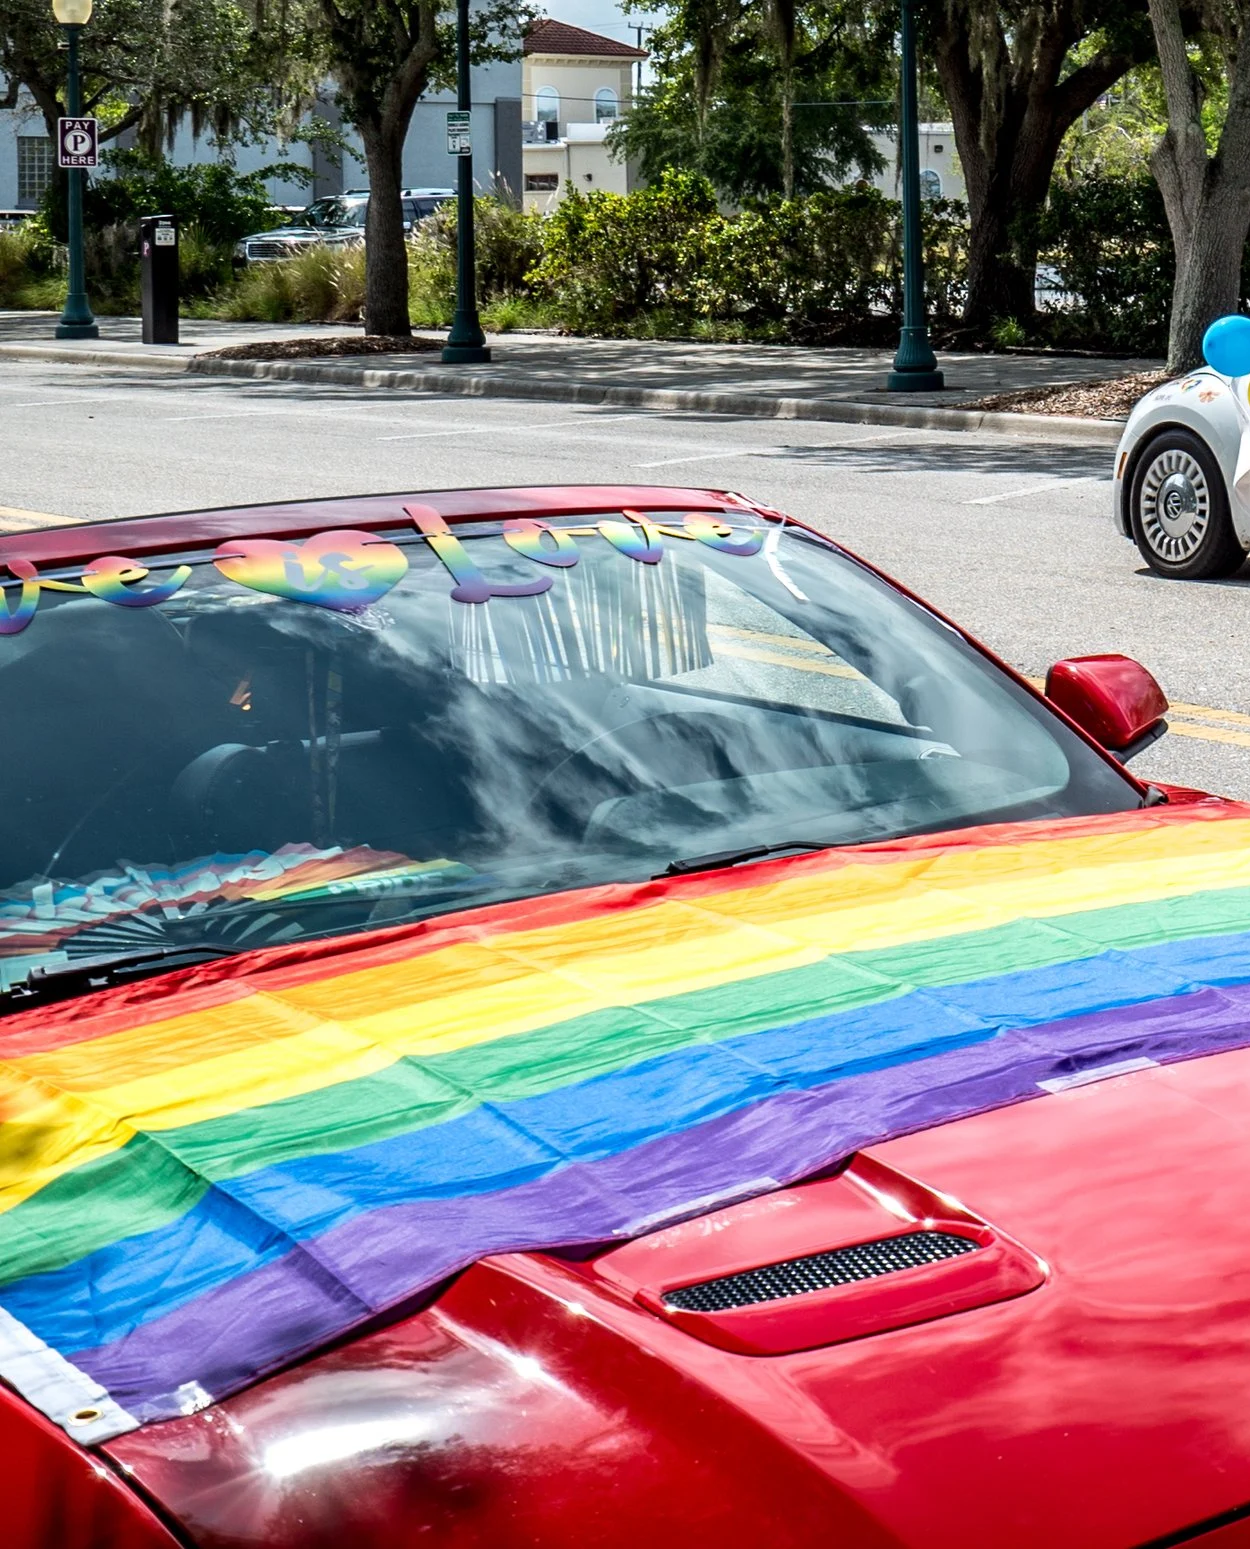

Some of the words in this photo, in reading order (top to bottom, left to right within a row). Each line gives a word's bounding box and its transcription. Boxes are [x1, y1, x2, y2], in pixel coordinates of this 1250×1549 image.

[65, 121, 90, 130] PAY
[72, 135, 86, 152] P
[62, 156, 95, 165] HERE
[282, 551, 375, 593] is
[402, 503, 764, 604] Love
